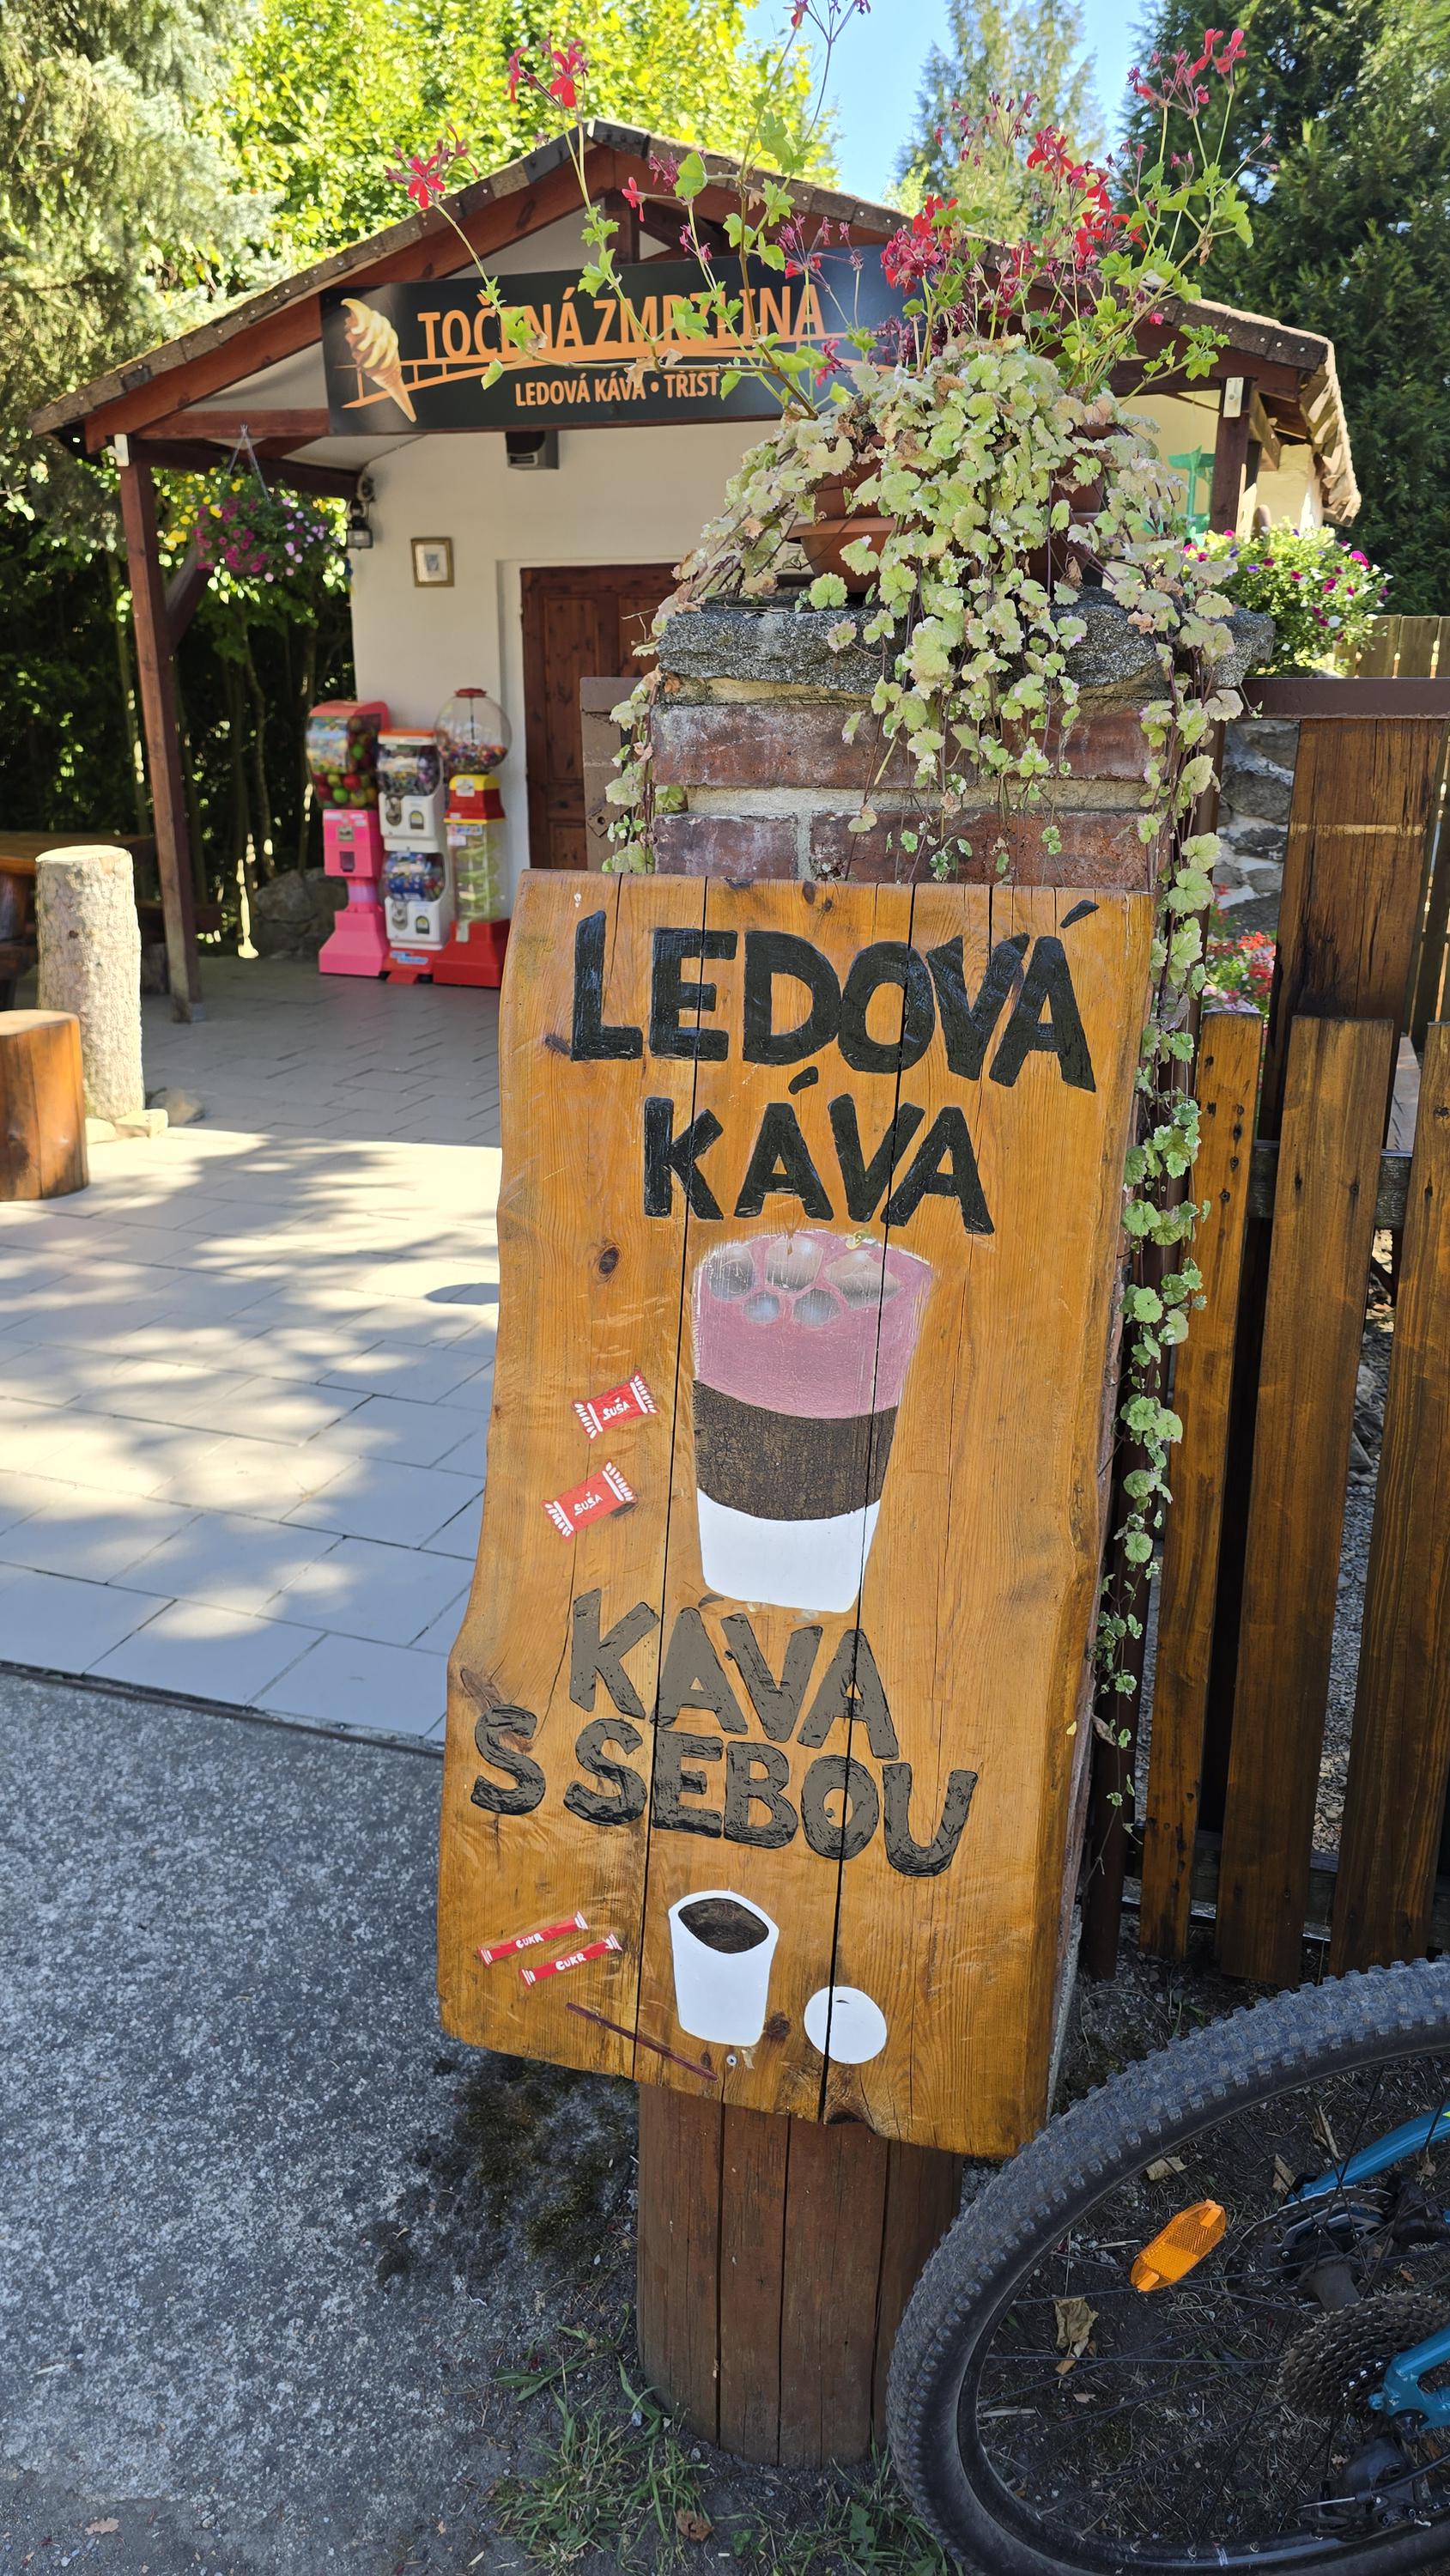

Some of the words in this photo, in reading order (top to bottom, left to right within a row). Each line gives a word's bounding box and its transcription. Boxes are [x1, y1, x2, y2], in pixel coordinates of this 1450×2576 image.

[593, 283, 825, 346] ZMRZLINA
[515, 373, 591, 407] LEDOVÁ
[594, 371, 646, 403] KÁVA
[569, 899, 1100, 1093] LEDOVÁ
[643, 1066, 996, 1236] KÁVA
[470, 1704, 547, 1817] S
[563, 1718, 980, 1878] SEBOU
[516, 1933, 544, 1948] CUKR
[556, 1953, 586, 1971] CUKR
